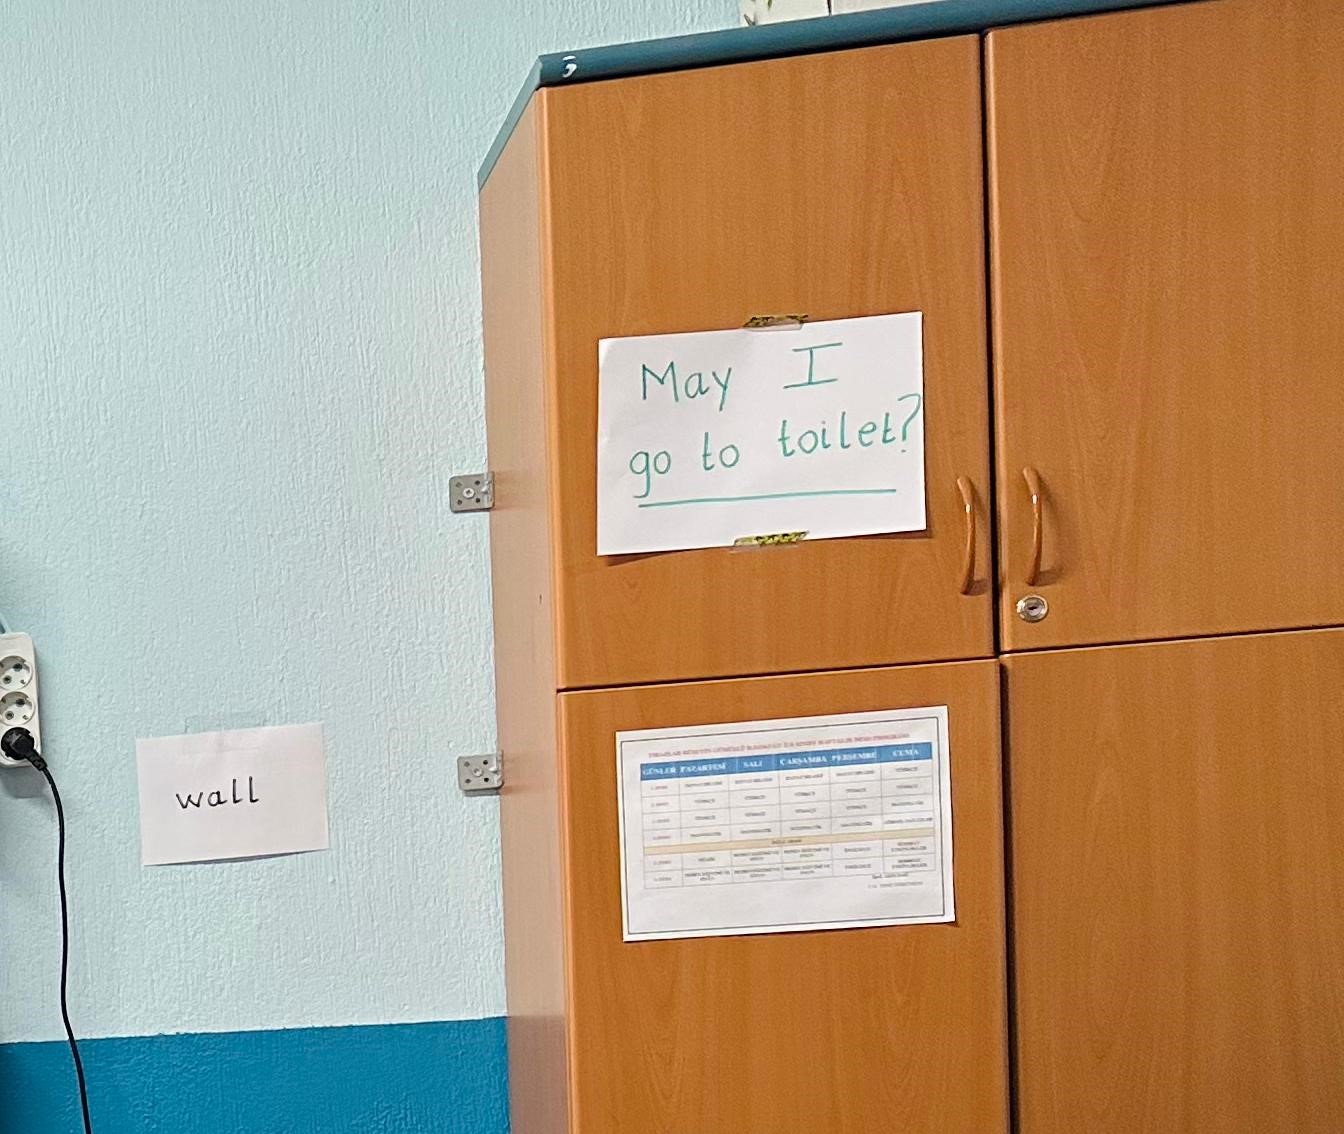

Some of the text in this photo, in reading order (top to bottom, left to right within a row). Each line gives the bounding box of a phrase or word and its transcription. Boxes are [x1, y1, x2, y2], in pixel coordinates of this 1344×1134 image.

[641, 341, 843, 412] May I
[629, 392, 922, 499] go to toilet?
[175, 775, 261, 809] wall
